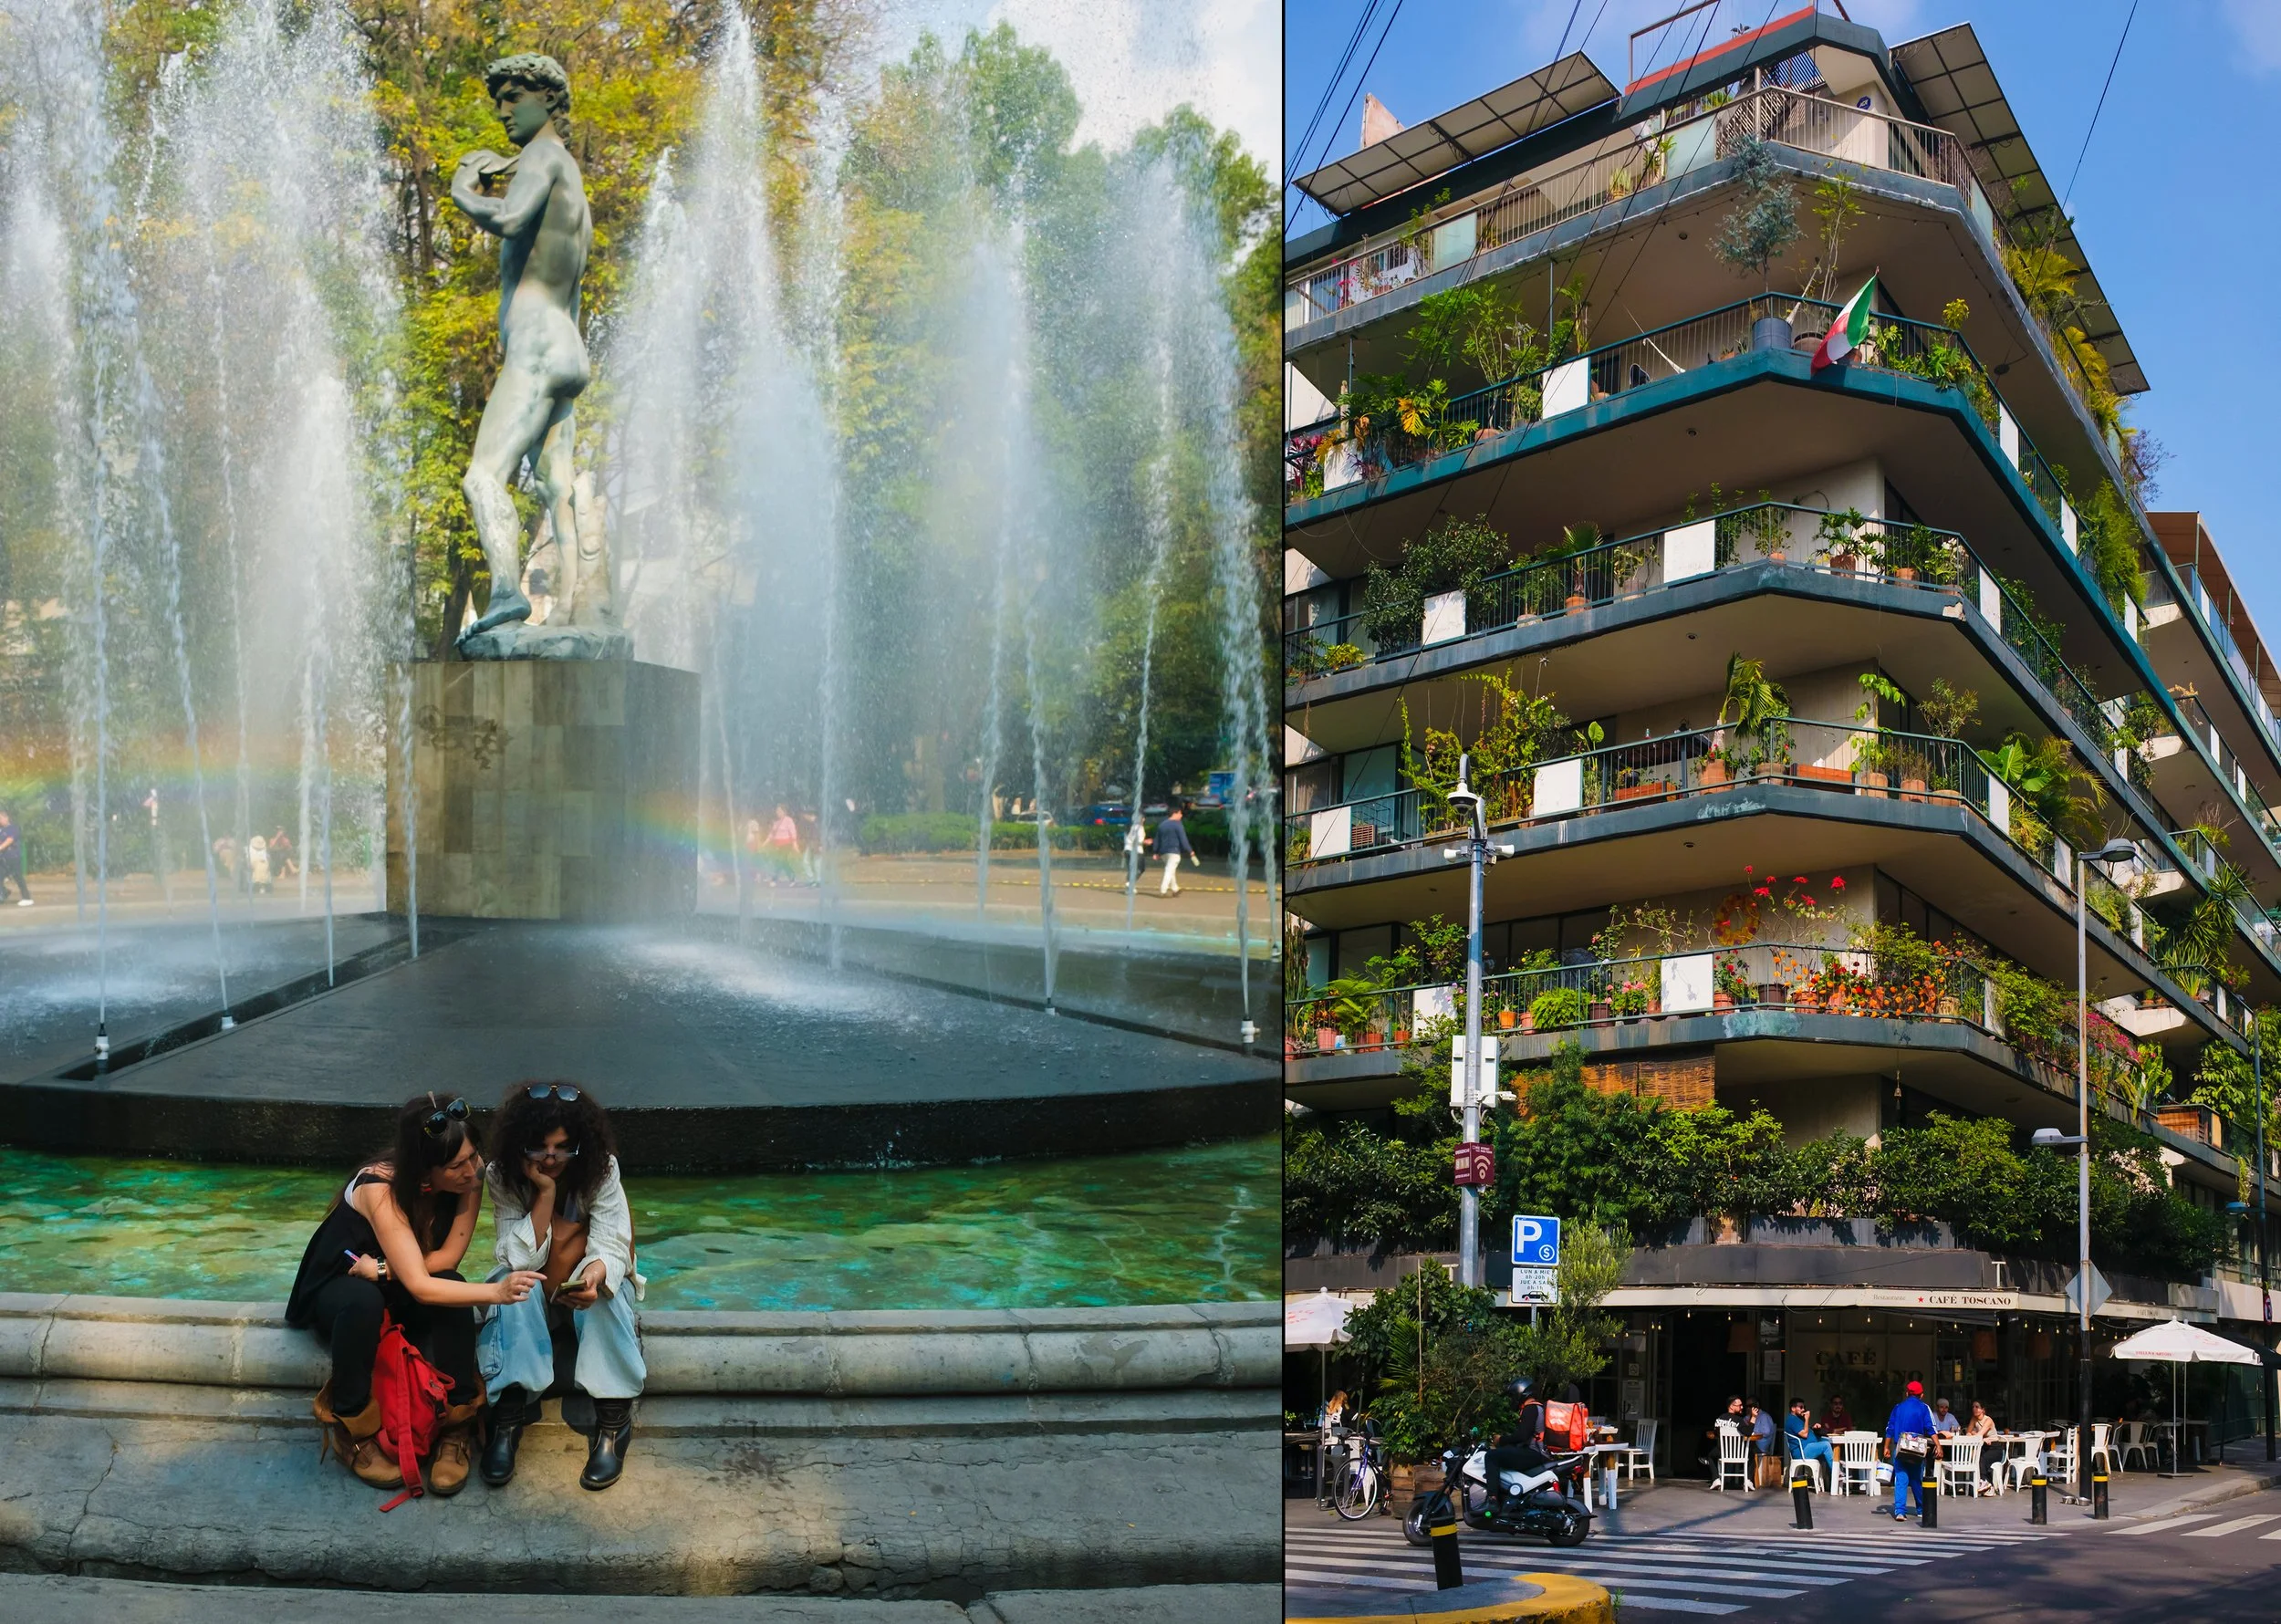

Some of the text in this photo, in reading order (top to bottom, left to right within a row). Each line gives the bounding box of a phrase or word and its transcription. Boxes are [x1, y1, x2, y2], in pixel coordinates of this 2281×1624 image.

[1516, 1220, 1542, 1254] P
[1929, 1294, 1957, 1305] CAFÉ
[1961, 1296, 2011, 1306] TOSCANO
[1815, 1348, 1876, 1365] CAFÉ
[1815, 1369, 1923, 1384] TOCANO
